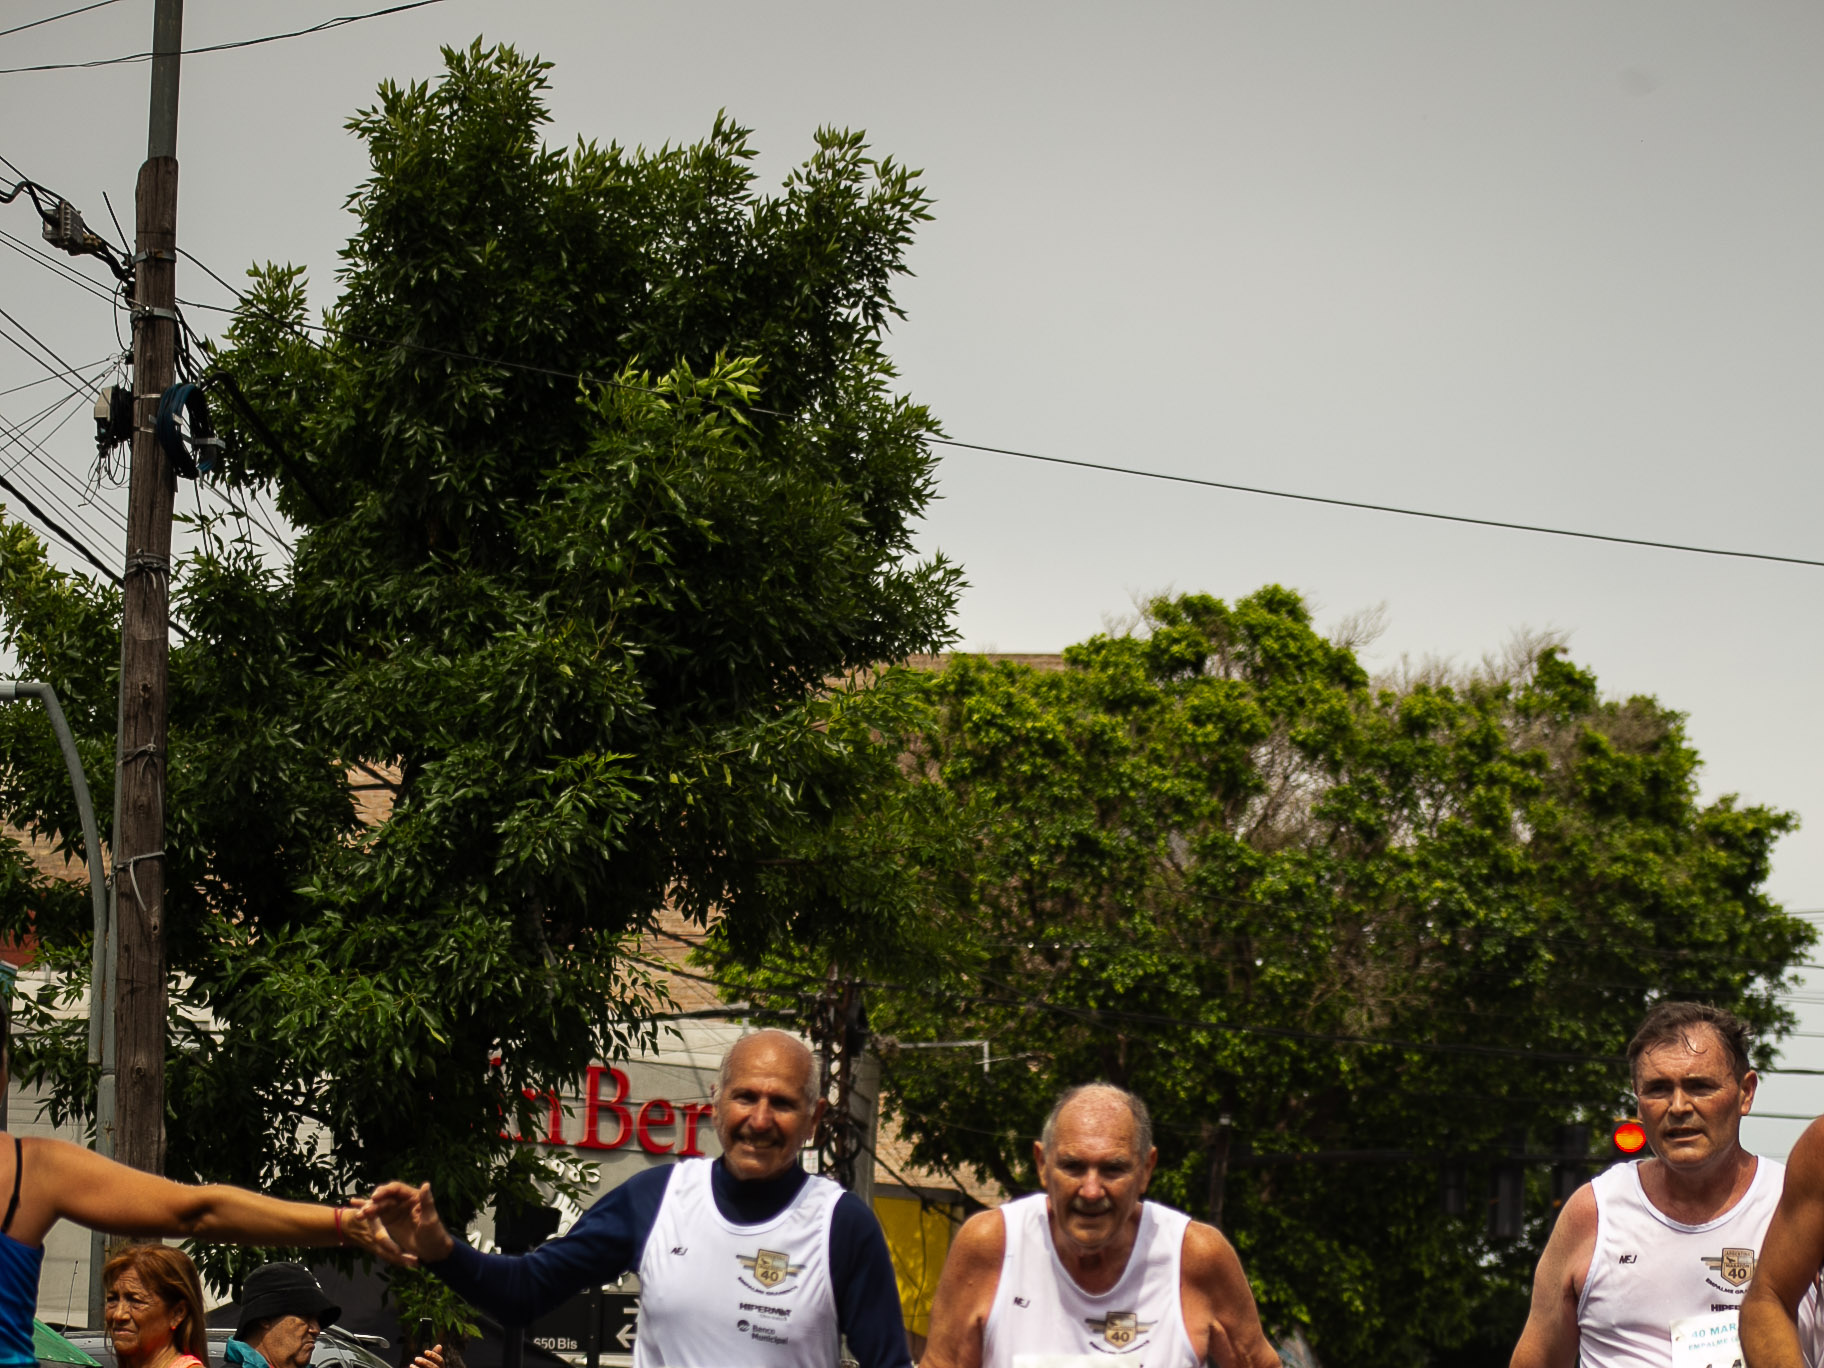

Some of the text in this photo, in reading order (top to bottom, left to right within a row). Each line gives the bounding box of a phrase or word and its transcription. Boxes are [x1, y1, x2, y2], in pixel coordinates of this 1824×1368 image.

[1619, 1255, 1637, 1264] NEJ
[761, 1270, 779, 1282] 40
[1728, 1268, 1747, 1279] 40
[1111, 1331, 1130, 1343] 40
[1692, 1330, 1706, 1338] 40
[557, 1337, 578, 1350] Bis
